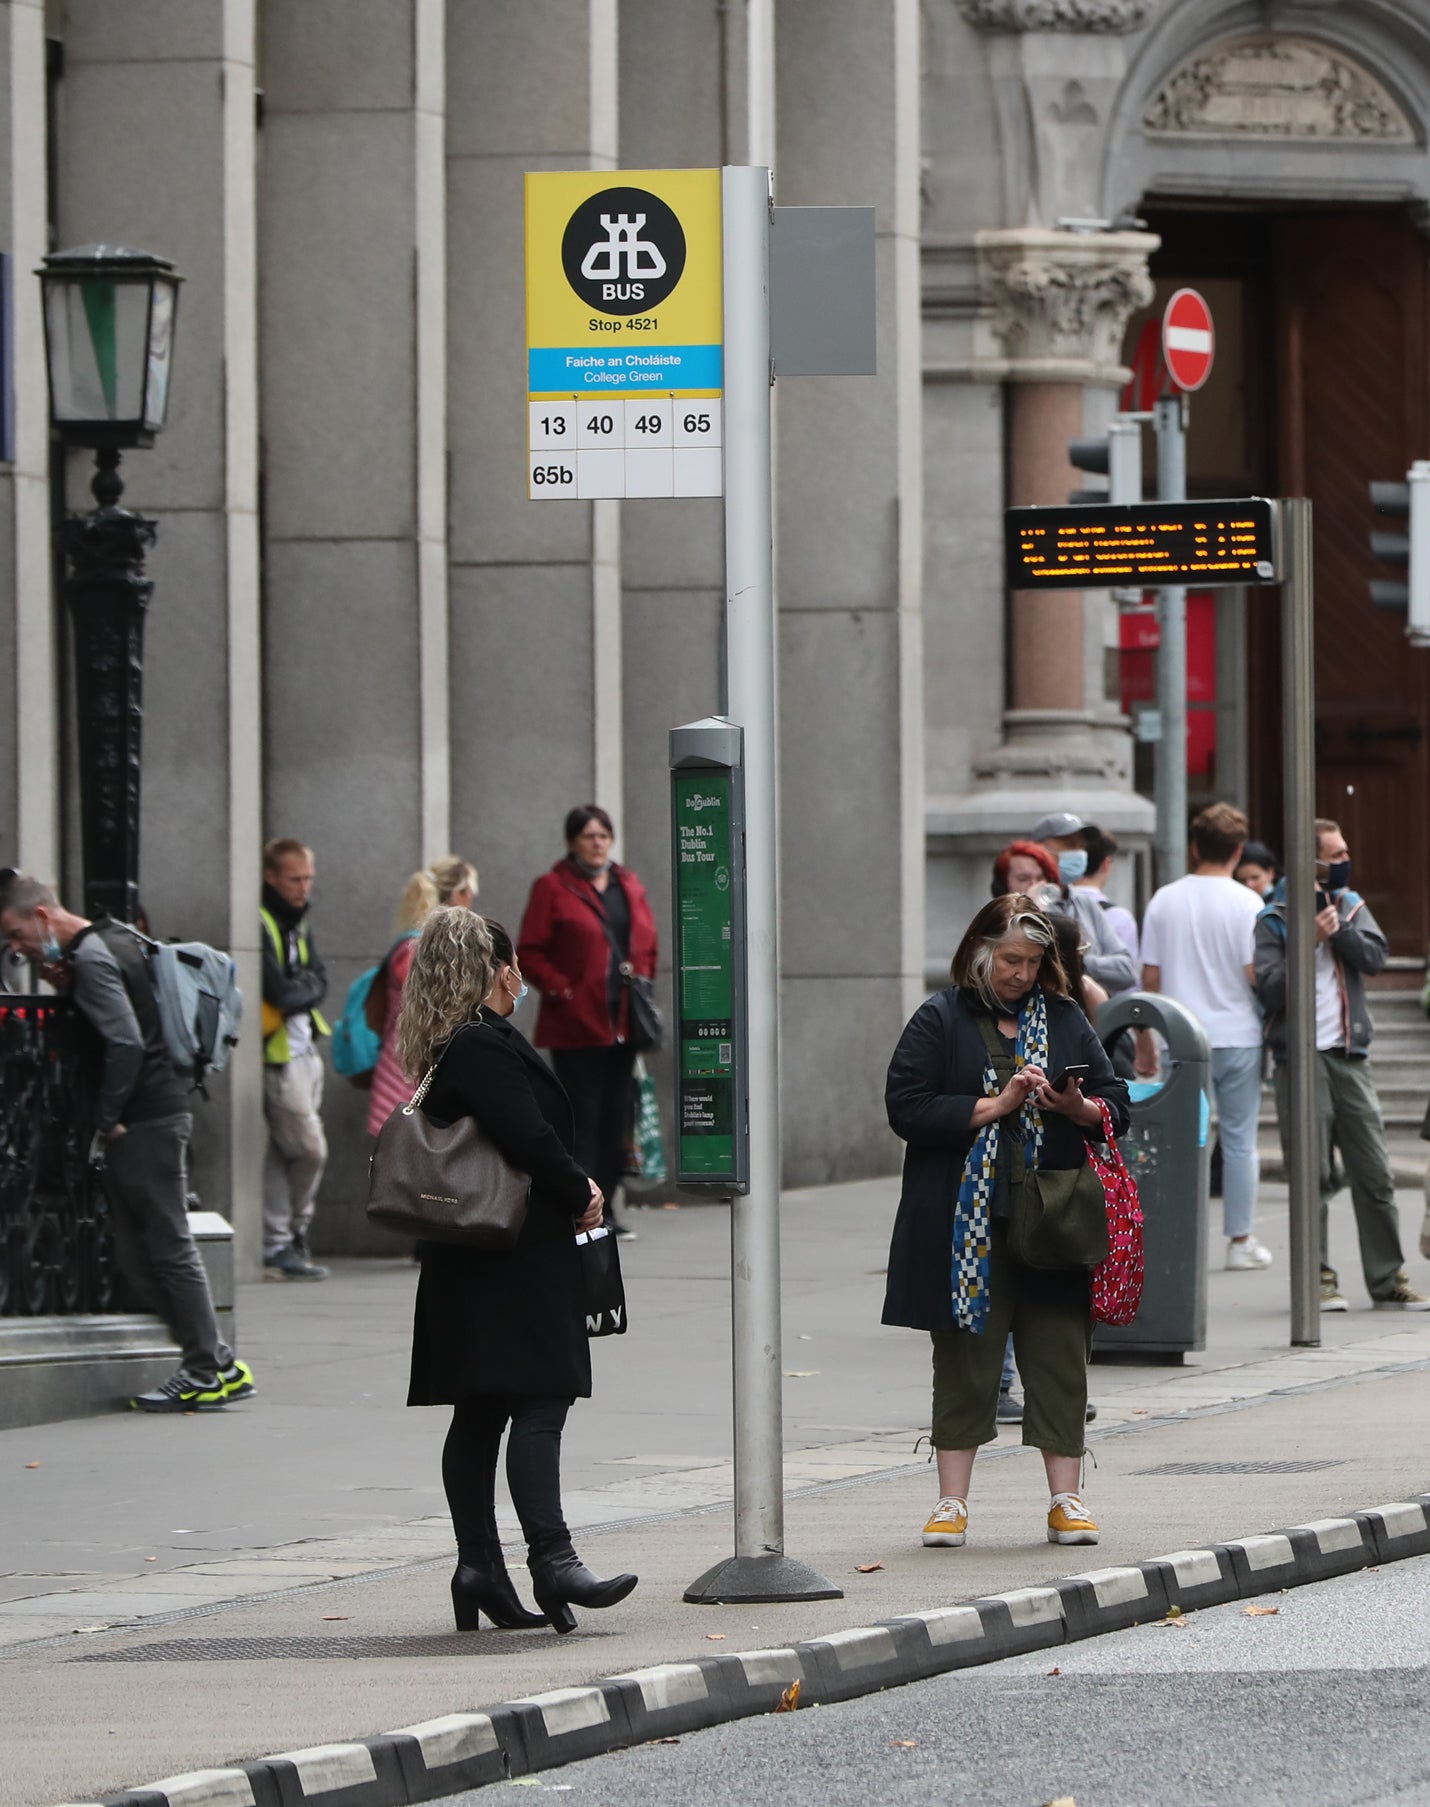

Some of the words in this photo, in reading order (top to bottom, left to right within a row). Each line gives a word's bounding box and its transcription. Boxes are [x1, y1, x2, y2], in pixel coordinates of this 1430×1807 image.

[602, 283, 645, 300] BUS
[589, 319, 622, 332] Stop
[626, 319, 659, 330] 4521
[566, 355, 605, 367] Faiche
[608, 357, 623, 367] an
[625, 354, 682, 366] Choláiste
[584, 371, 626, 384] College
[629, 370, 663, 382] Green
[540, 417, 566, 435] 13
[586, 416, 614, 434] 40
[635, 415, 662, 433] 49
[683, 414, 711, 433] 65
[533, 466, 573, 485] 65b
[680, 826, 695, 837] The
[696, 825, 713, 836] No.1
[681, 839, 707, 850] Dublin
[681, 852, 695, 862] Bus
[696, 851, 716, 862] Tour
